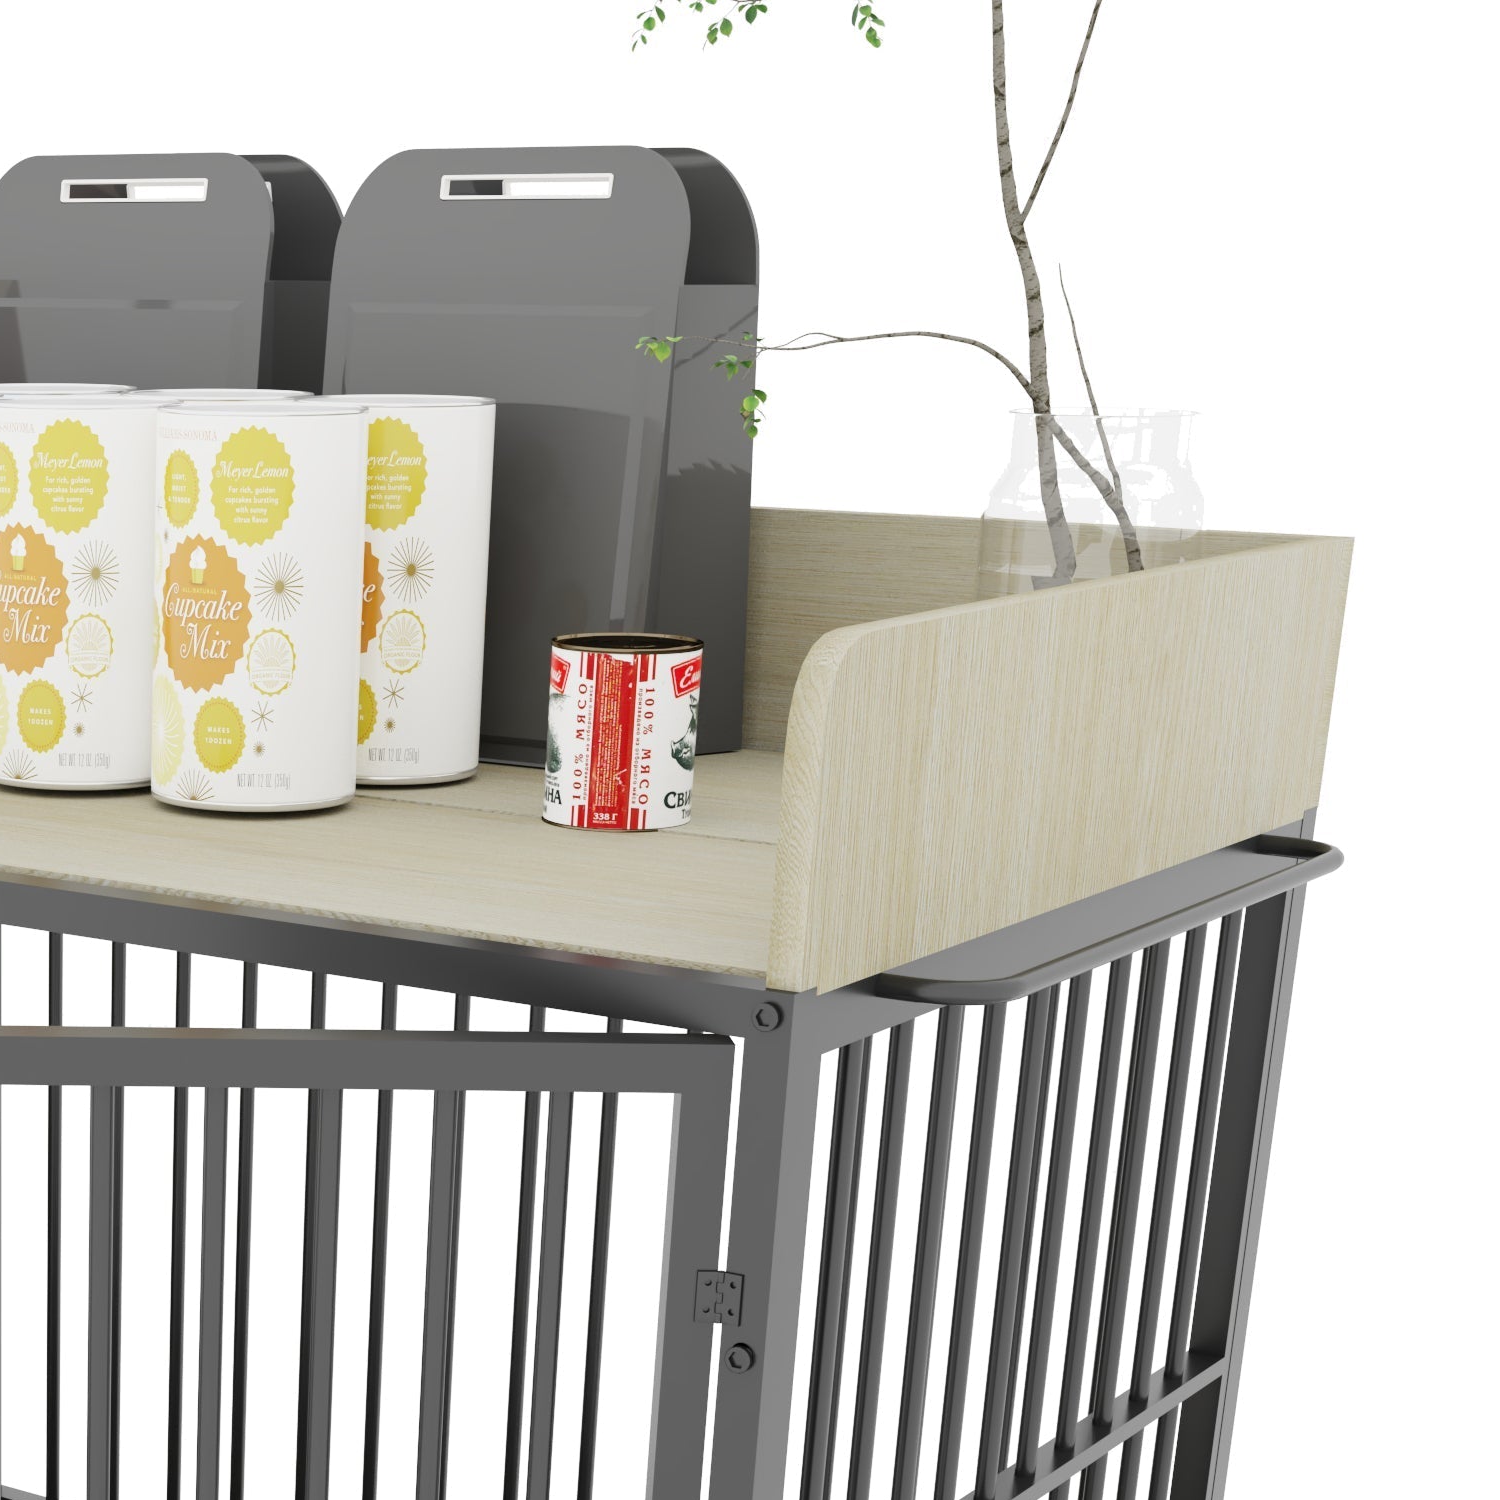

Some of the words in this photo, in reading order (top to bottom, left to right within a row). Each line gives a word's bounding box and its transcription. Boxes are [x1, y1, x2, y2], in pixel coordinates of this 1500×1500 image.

[34, 452, 69, 471] Meyer
[68, 452, 103, 470] Lemon
[367, 456, 388, 470] eyer
[388, 450, 421, 467] Lemon
[217, 461, 254, 481] Meyer
[253, 461, 289, 479] Lemon
[389, 474, 409, 482] golden
[70, 486, 93, 494] bursting
[71, 477, 90, 485] golden
[228, 486, 238, 494] For
[255, 486, 276, 495] golden
[388, 483, 412, 492] bursting
[253, 497, 279, 505] bursting
[386, 502, 402, 510] flavor
[234, 516, 251, 524] citrus
[252, 516, 268, 524] flavor
[165, 583, 242, 627] Cupcake
[4, 608, 50, 643] Mix
[180, 622, 231, 660] Mix
[576, 684, 587, 740] МЯСО
[643, 688, 655, 735] 100%
[237, 774, 246, 786] NET
[572, 754, 584, 799] 100%
[638, 749, 651, 805] МЯСО
